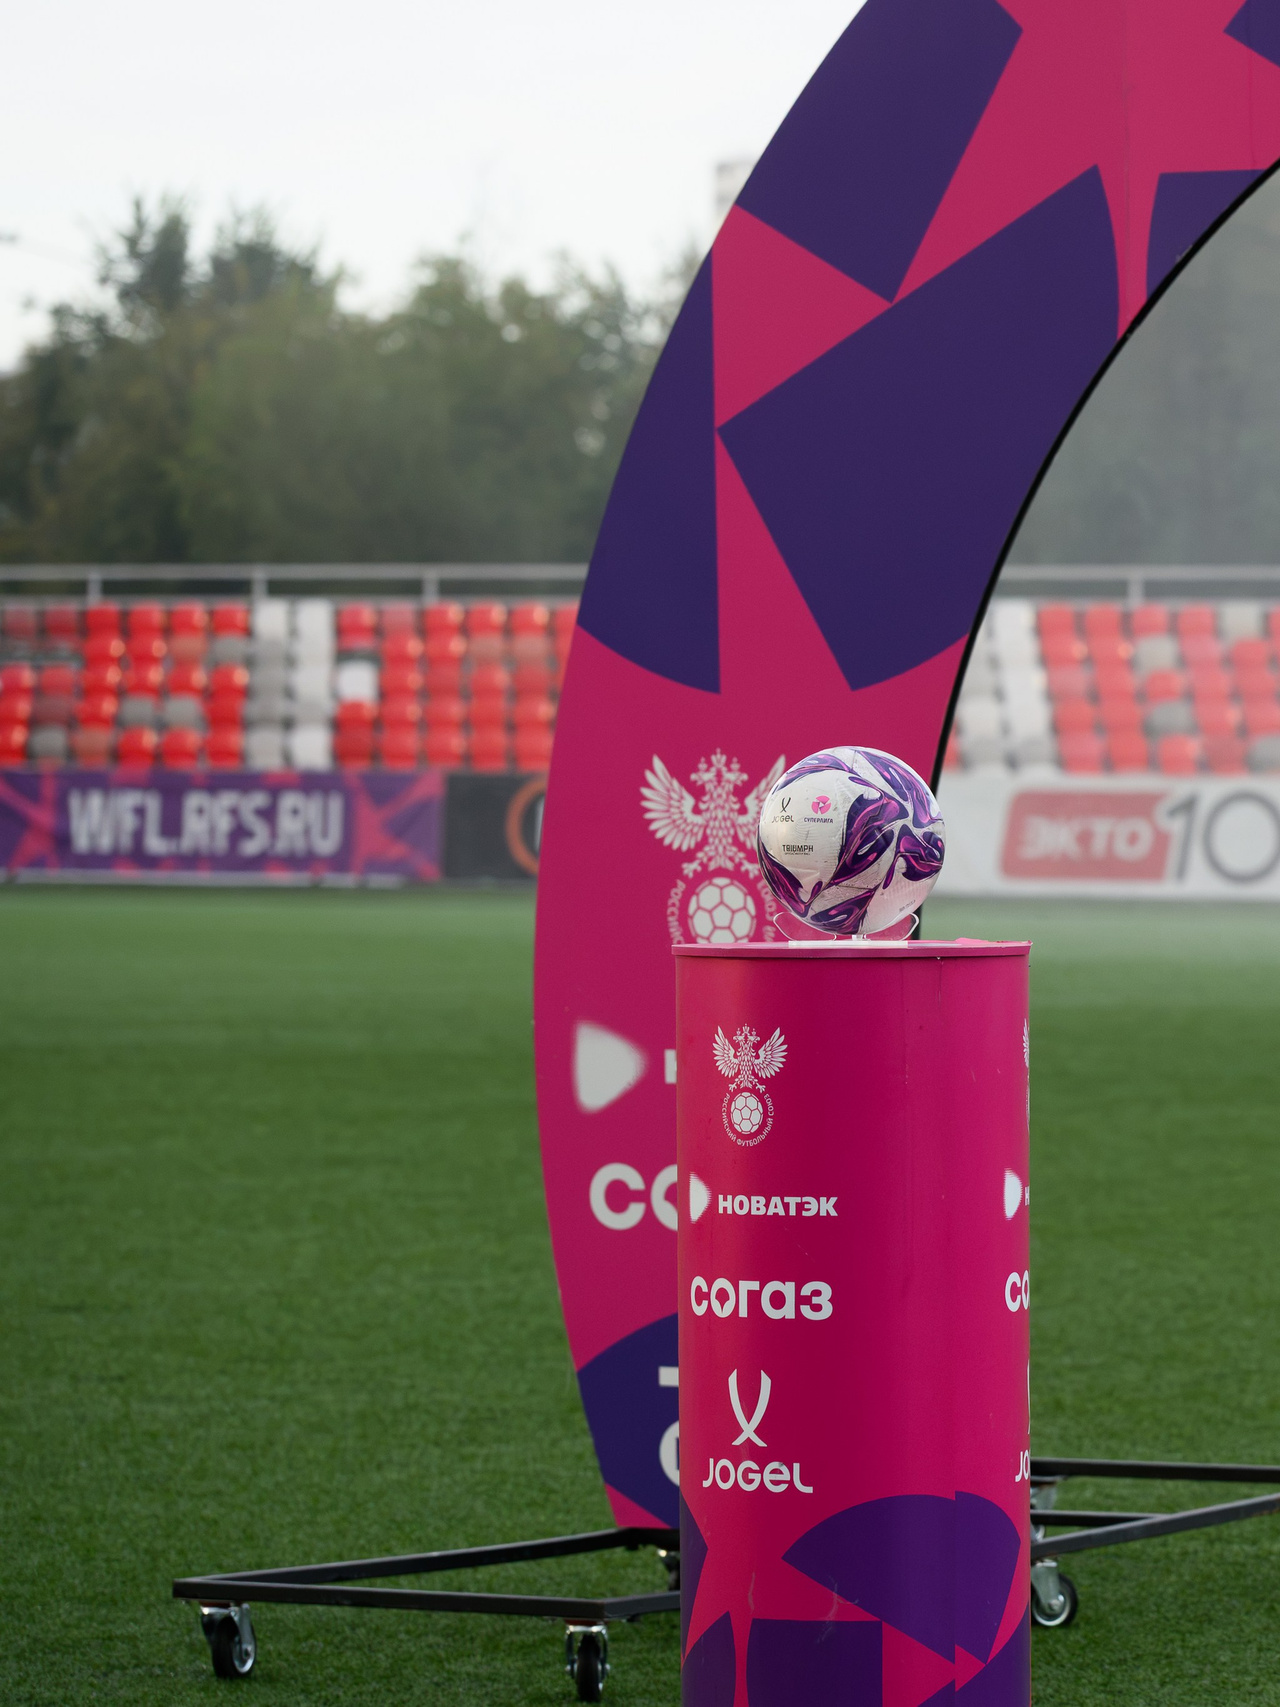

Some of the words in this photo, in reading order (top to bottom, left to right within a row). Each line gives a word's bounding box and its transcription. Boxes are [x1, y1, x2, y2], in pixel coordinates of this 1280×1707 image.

[68, 787, 345, 857] WFL.RFS.RU
[1018, 816, 1154, 862] ЭКТО
[782, 844, 814, 853] TRIUMPH
[718, 1194, 839, 1217] НОВАТЭК
